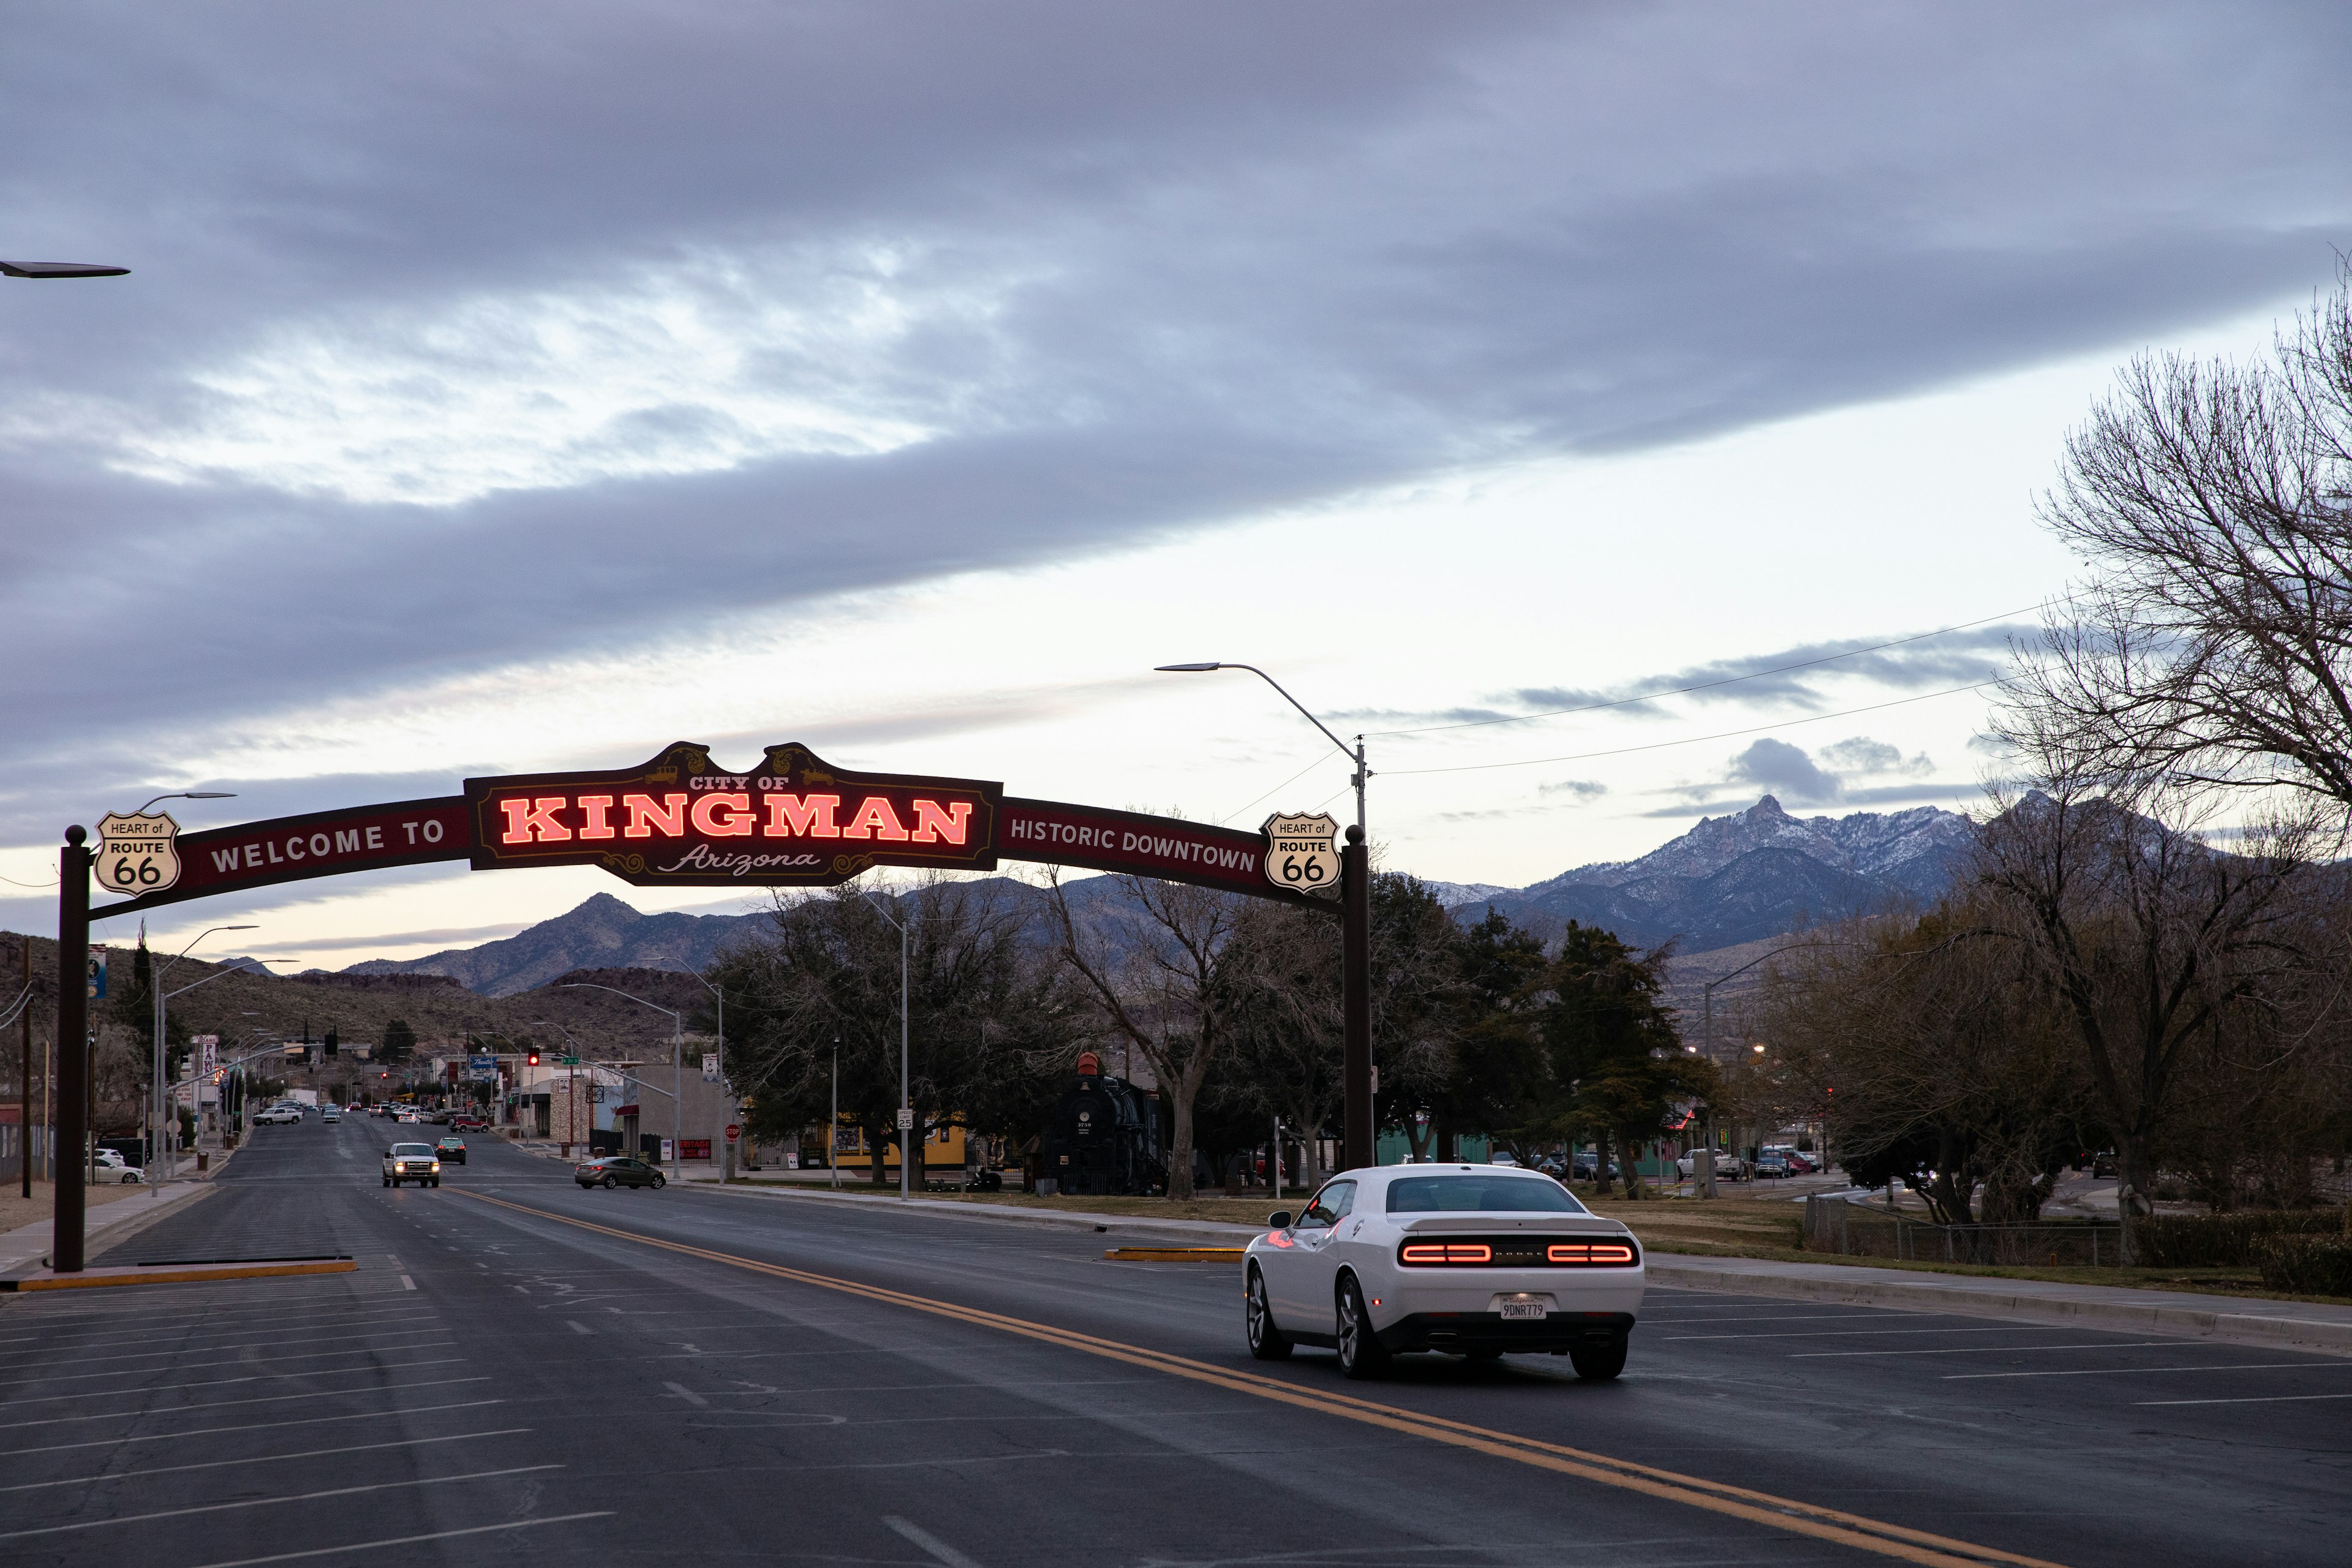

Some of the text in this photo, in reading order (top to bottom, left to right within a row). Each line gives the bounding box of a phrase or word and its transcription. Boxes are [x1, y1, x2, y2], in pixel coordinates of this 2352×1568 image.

[690, 777, 788, 790] CITY OF
[111, 823, 163, 834] HEART of
[500, 793, 973, 845] KINGMAN
[1280, 824, 1325, 833] HEART of
[111, 843, 164, 853] ROUTE
[211, 820, 443, 873] WELCOME TO
[1011, 819, 1256, 872] HISTORIC DOWNTOWN
[1280, 842, 1327, 852] ROUTE
[657, 844, 821, 876] Arizona
[1283, 854, 1324, 882] 66
[114, 856, 160, 885] 66
[1504, 1304, 1543, 1316] 9DNR779
